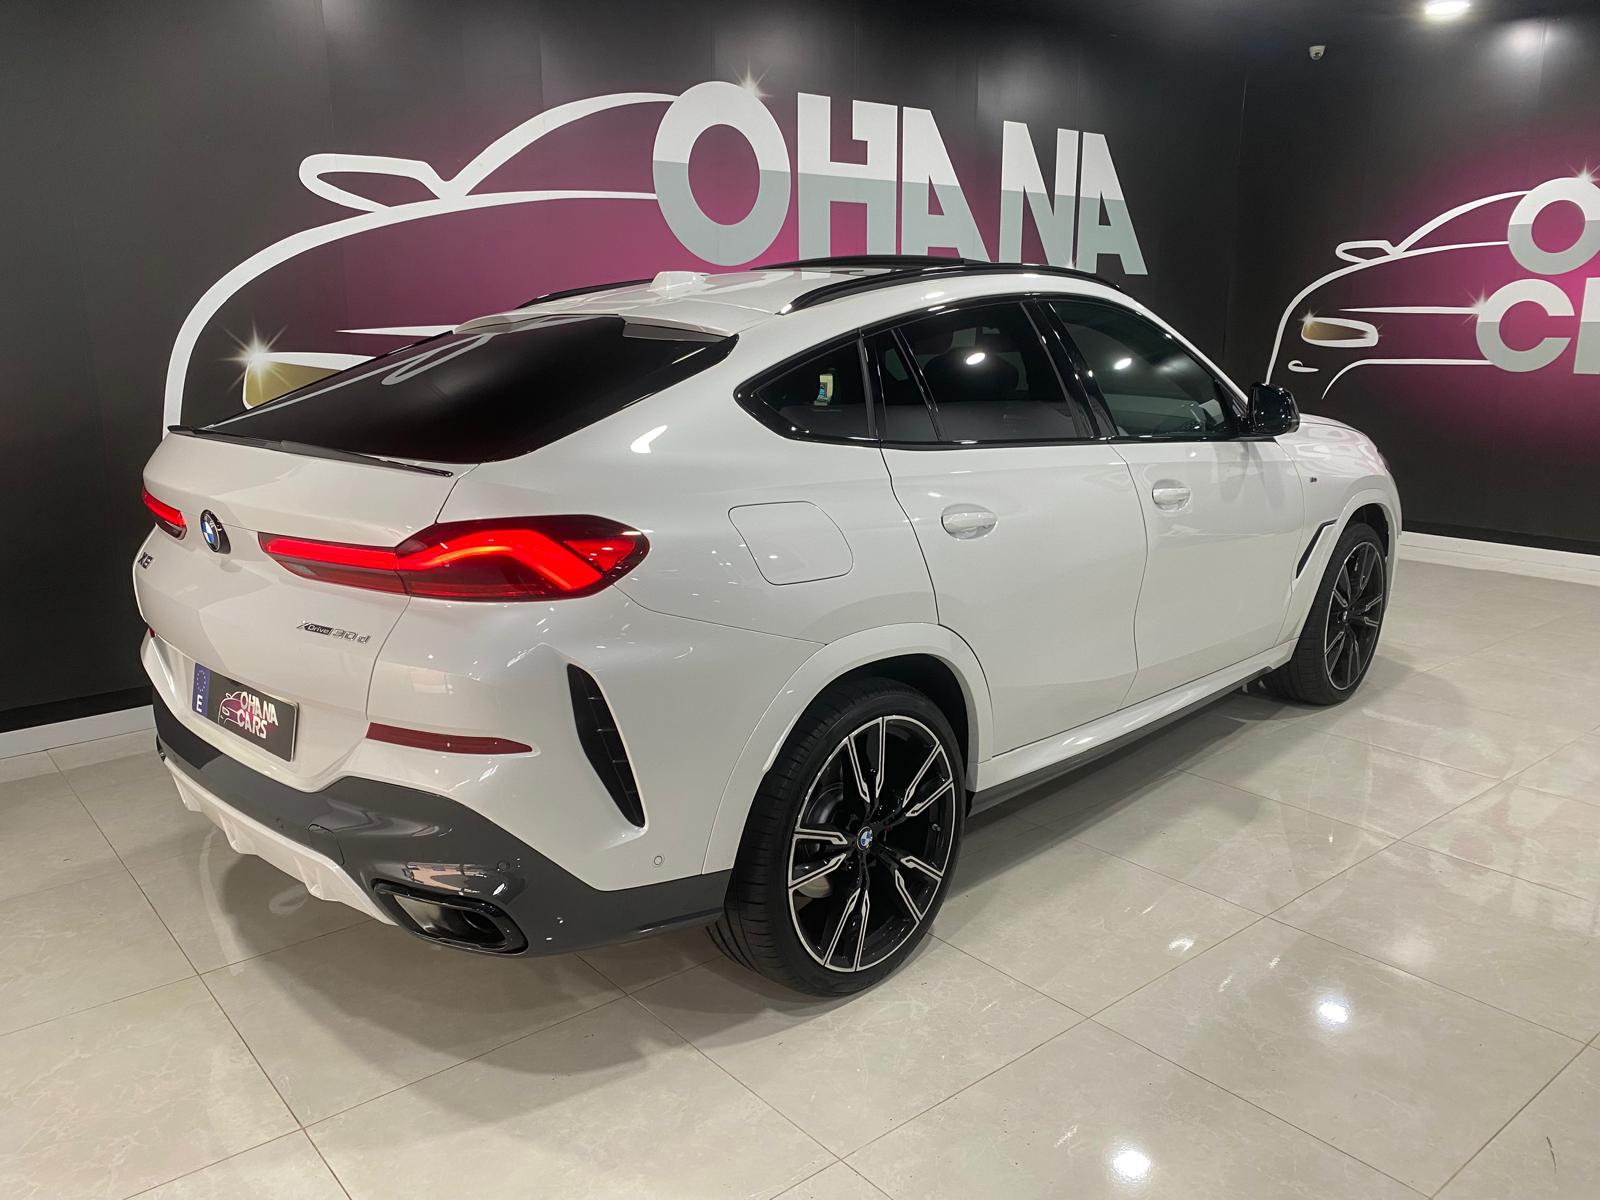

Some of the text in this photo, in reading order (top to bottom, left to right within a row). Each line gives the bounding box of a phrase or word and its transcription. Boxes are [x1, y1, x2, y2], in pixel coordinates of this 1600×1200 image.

[652, 81, 1148, 276] OHANA
[196, 694, 203, 713] E
[240, 691, 279, 727] OHANA
[237, 709, 268, 739] CARS
